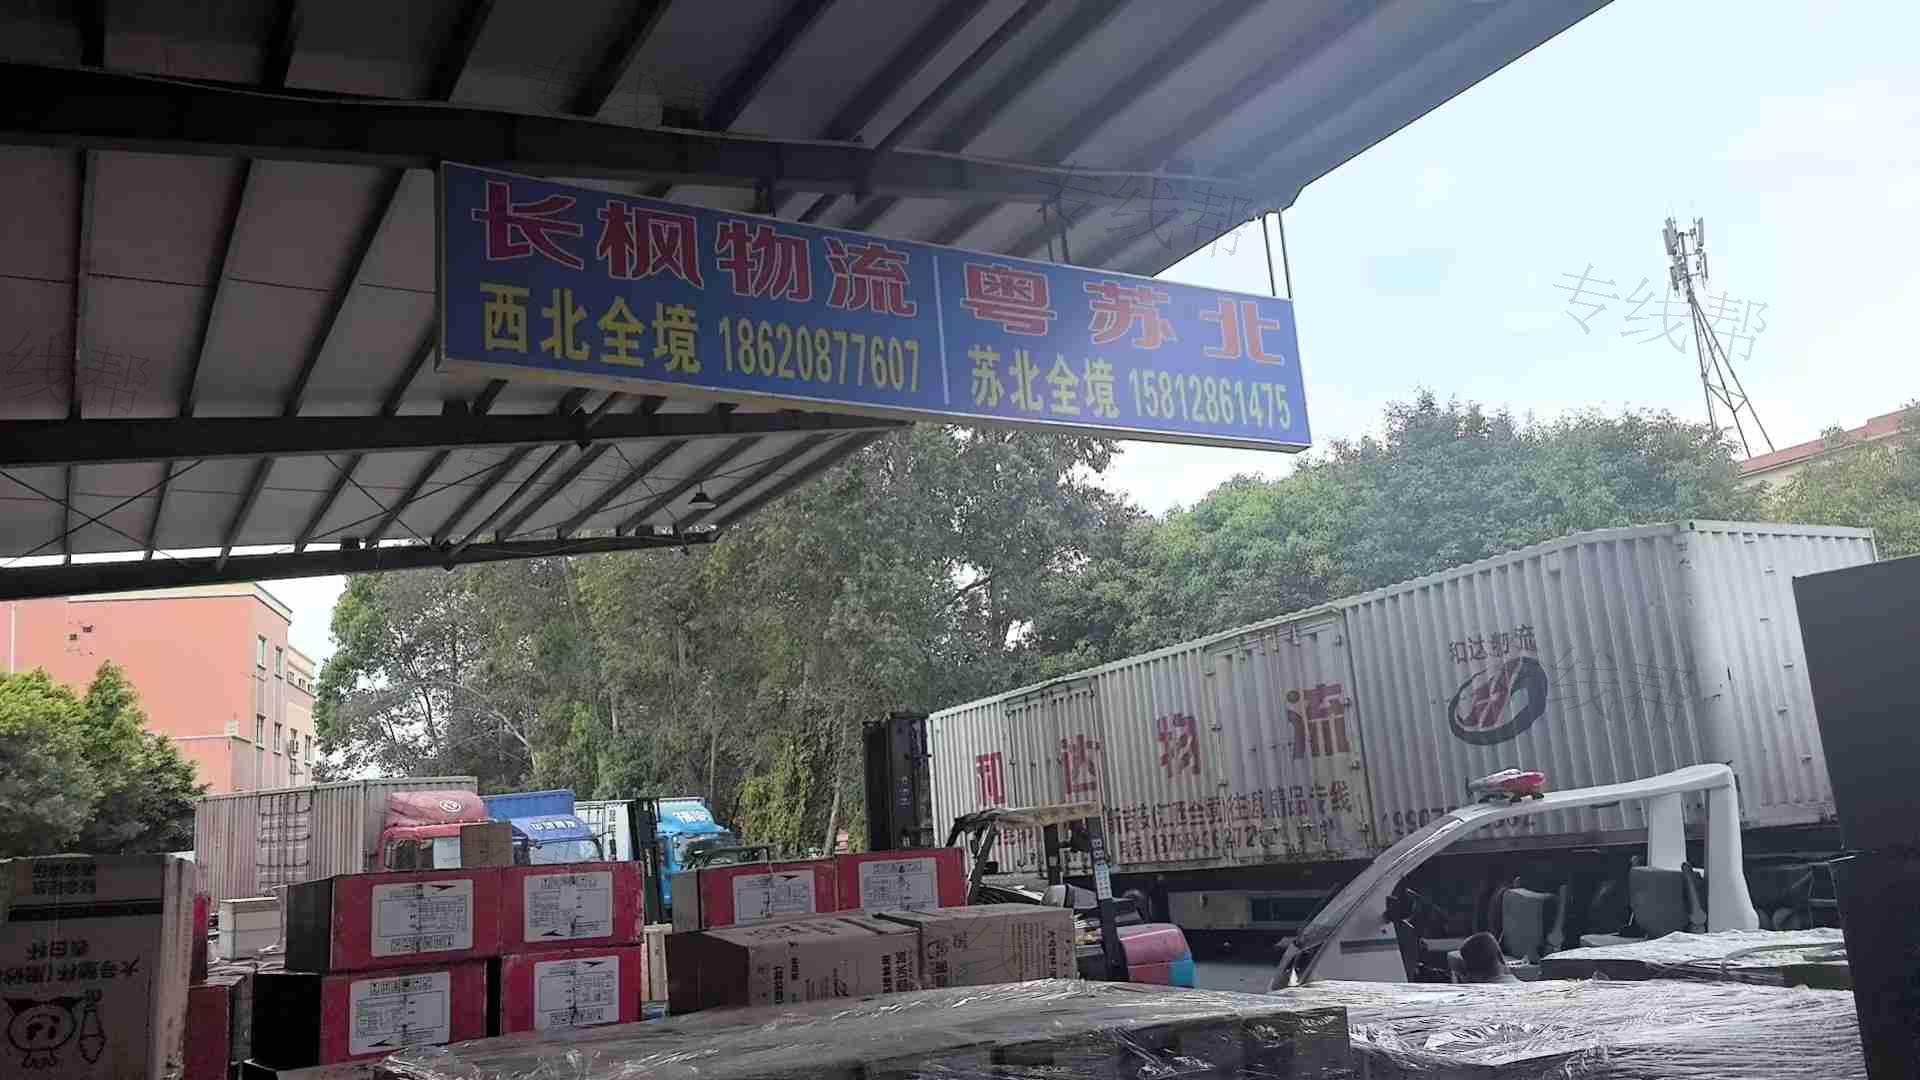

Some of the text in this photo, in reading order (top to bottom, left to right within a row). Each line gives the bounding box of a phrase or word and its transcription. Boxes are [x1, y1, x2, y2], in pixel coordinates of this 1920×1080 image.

[471, 180, 918, 317] 长枫物流
[479, 280, 921, 392] 西北全境 18620877607
[960, 261, 1285, 366] 粤苏北
[967, 343, 1292, 431] 苏北全境 15812861475
